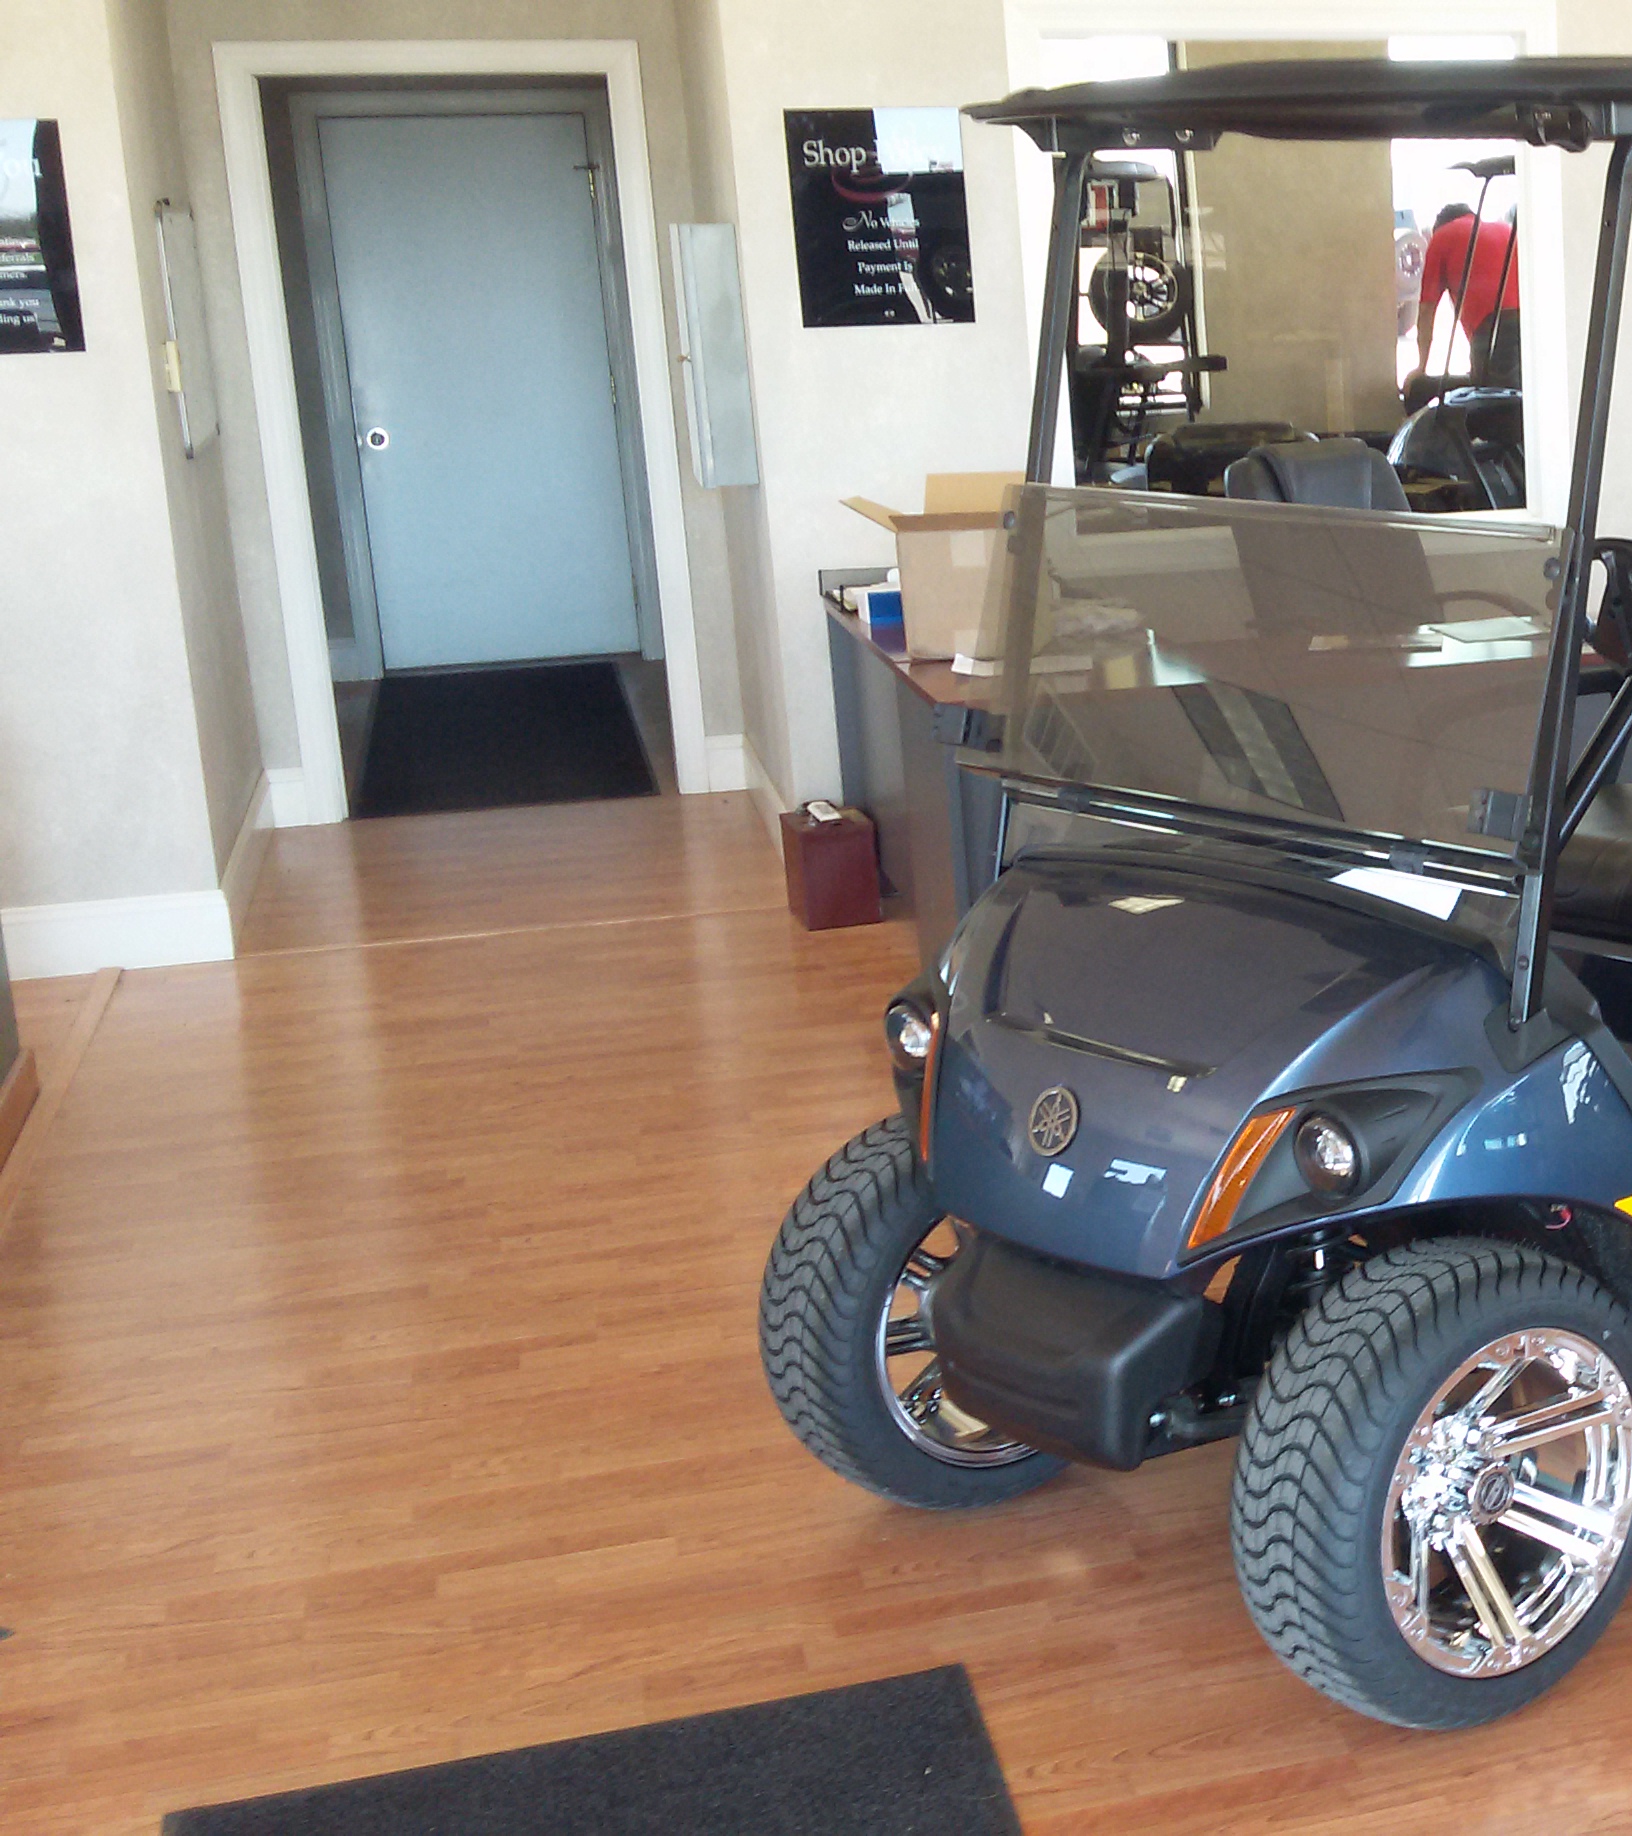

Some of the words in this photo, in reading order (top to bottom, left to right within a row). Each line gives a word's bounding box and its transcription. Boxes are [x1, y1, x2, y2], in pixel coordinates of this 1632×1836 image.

[803, 139, 867, 175] Shop
[842, 210, 878, 232] No
[847, 238, 892, 252] Released
[893, 238, 919, 250] Until
[857, 261, 902, 276] Payment
[903, 260, 914, 273] Is
[853, 281, 883, 296] Made
[884, 282, 896, 296] In
